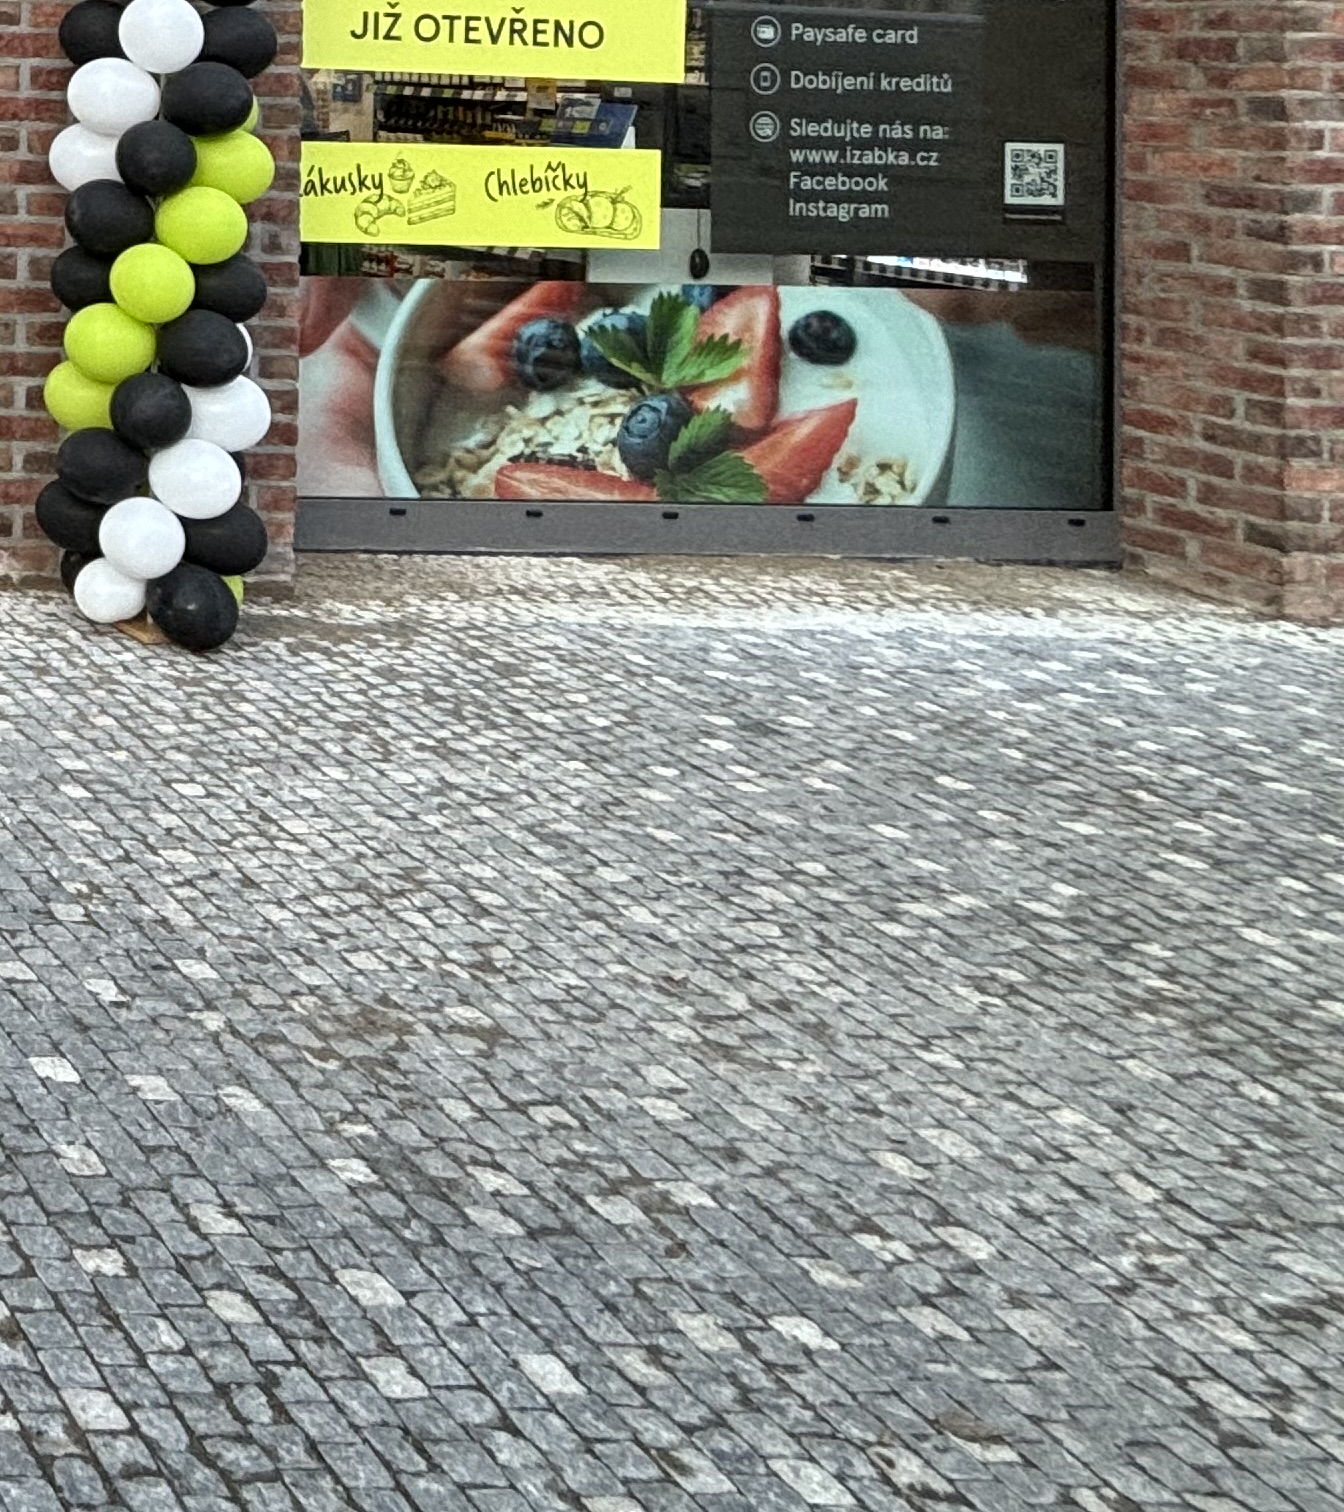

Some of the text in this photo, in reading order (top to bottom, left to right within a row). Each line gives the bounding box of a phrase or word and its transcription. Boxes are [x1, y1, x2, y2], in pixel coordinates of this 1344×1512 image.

[350, 1, 605, 50] JIŽ OTEVŘENO
[790, 23, 919, 46] Paysafe card
[790, 70, 953, 94] Dobíjení kreditů
[789, 117, 950, 142] Sledujte nás na:
[789, 146, 940, 166] www.izabka.cz
[299, 161, 588, 204] ákusky Chlebíčky
[789, 170, 889, 192] Facebook
[789, 198, 890, 223] Instagram
